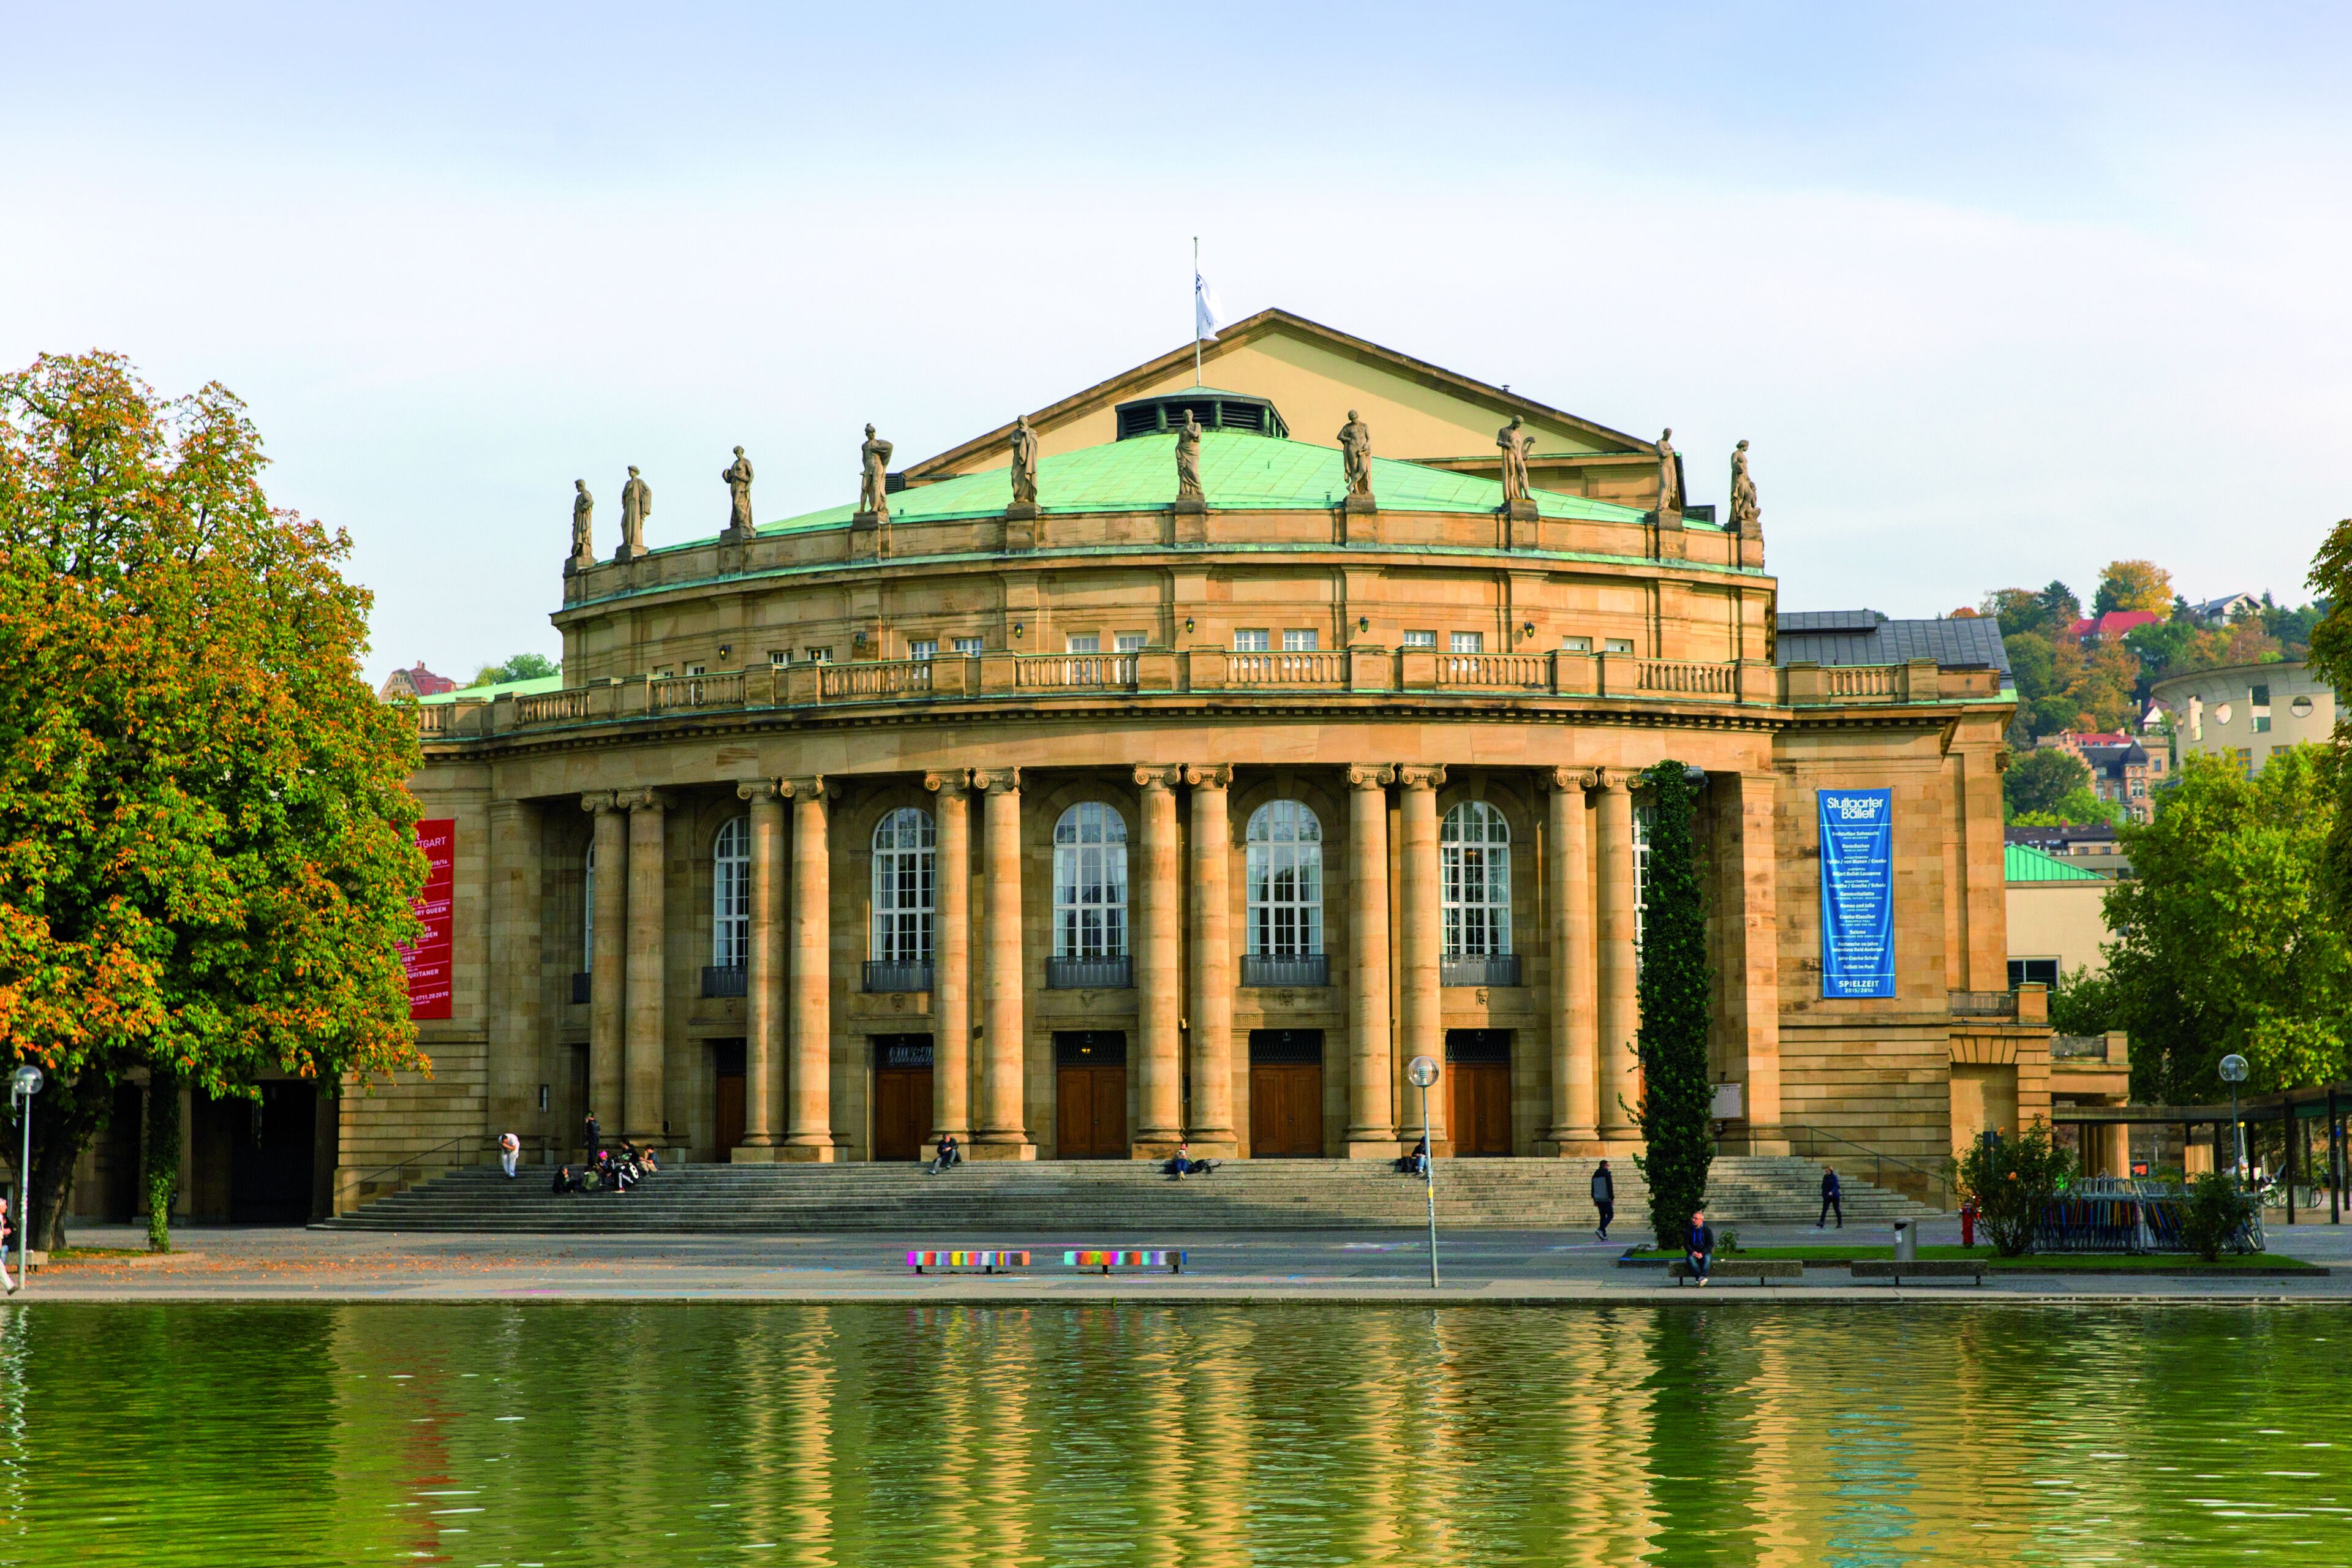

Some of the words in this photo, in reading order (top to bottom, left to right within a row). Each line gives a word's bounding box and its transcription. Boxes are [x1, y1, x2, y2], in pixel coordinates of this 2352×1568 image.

[1827, 797, 1883, 812] Stuttgarter
[1841, 808, 1875, 819] Ballett
[413, 836, 447, 848] TTGART
[426, 906, 447, 914] QUEEN
[407, 969, 439, 979] URITANER
